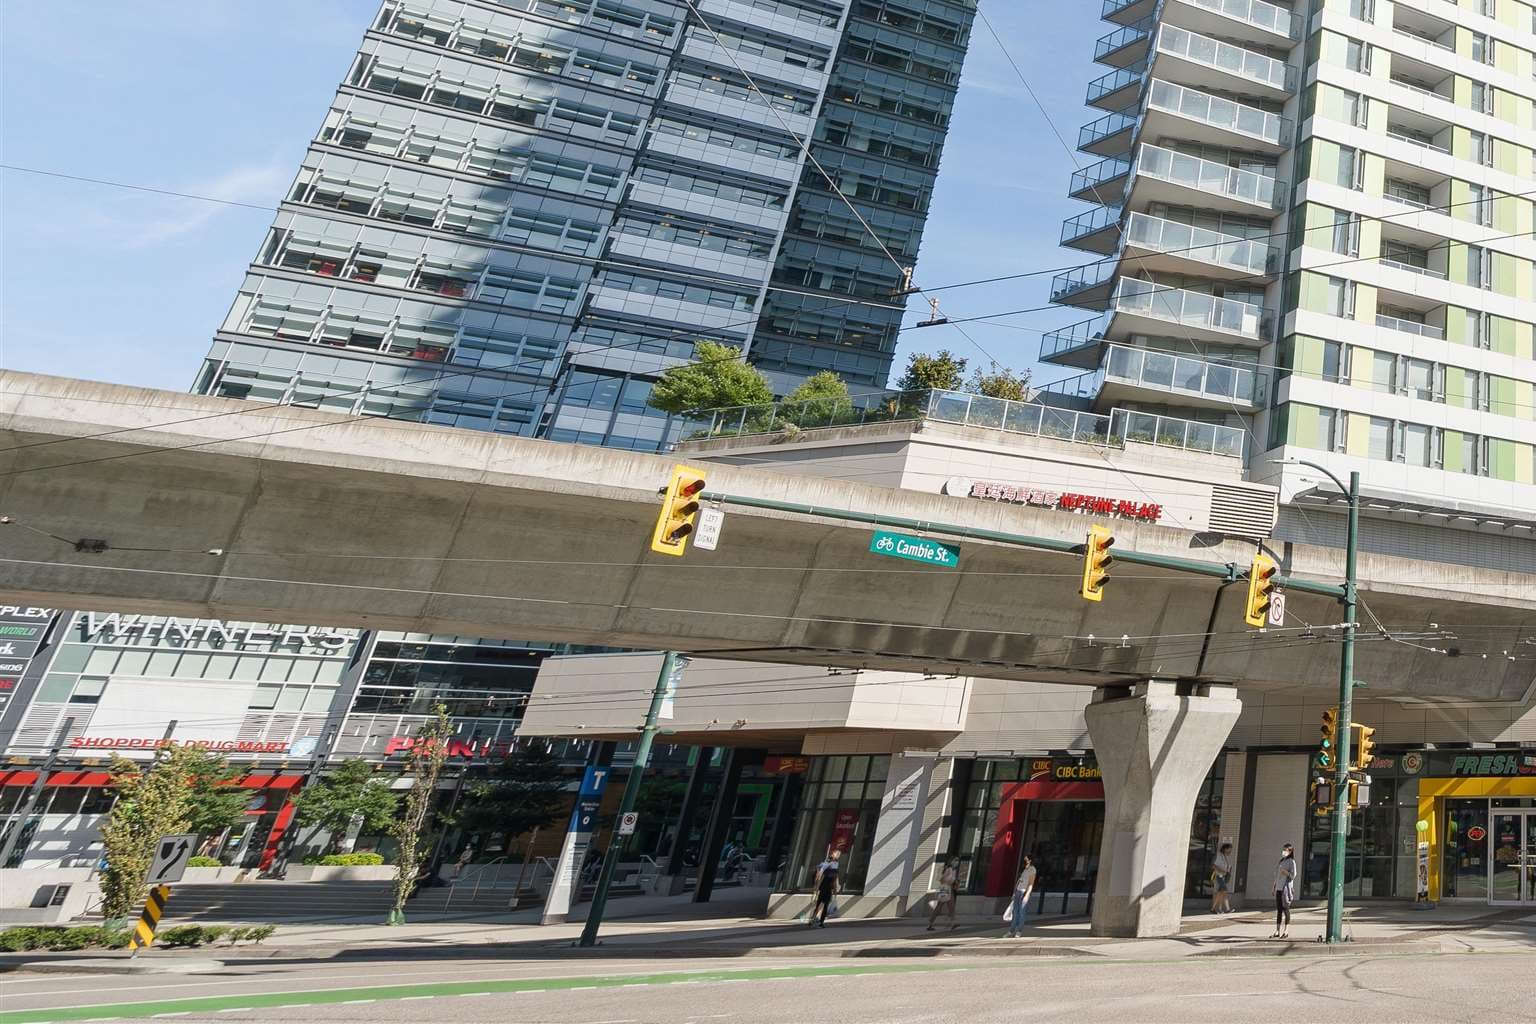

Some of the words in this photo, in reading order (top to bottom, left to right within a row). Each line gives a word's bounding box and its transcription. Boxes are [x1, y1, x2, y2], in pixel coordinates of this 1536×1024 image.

[1060, 493, 1116, 513] NEPTUNE
[1119, 500, 1162, 519] PALACE
[896, 539, 934, 560] Cambie
[935, 547, 950, 563] St.
[0, 605, 52, 618] PLEX
[86, 611, 360, 650] WINNERS
[185, 739, 234, 751] DRUG
[236, 741, 290, 753] MART
[1033, 760, 1051, 770] CIBC
[1056, 766, 1078, 778] CIBC
